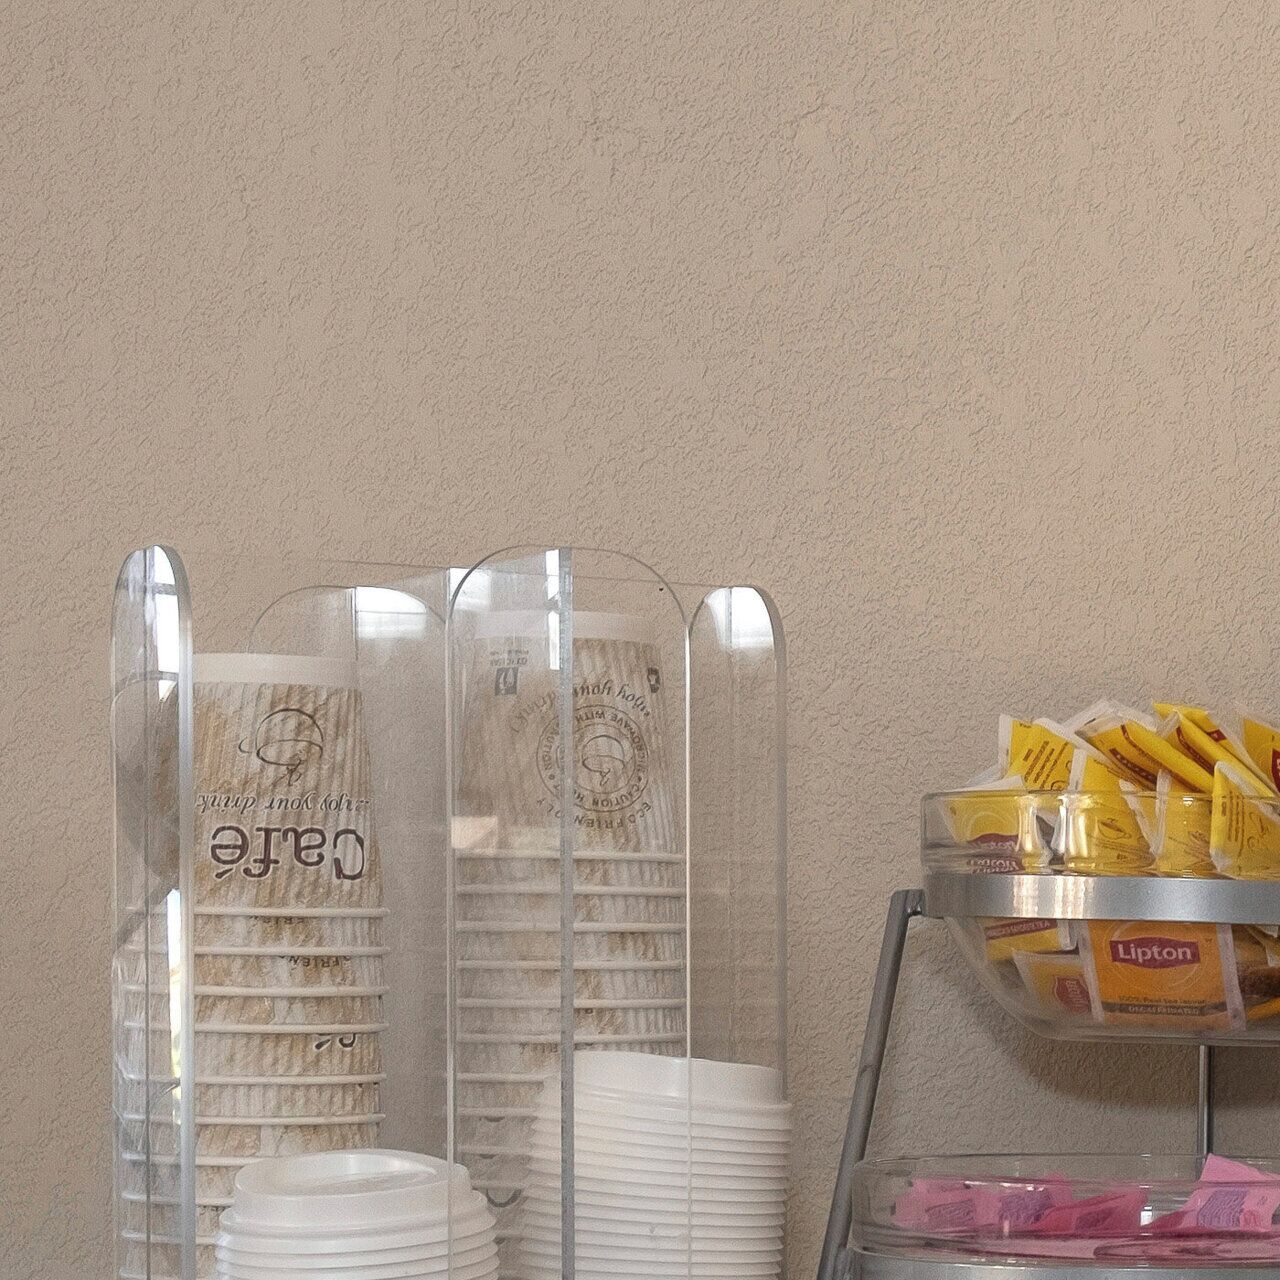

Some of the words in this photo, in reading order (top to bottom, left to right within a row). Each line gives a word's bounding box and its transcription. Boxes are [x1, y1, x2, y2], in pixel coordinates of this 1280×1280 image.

[198, 793, 257, 815] drink
[265, 792, 316, 812] your
[591, 784, 640, 807] CAUTION
[210, 825, 365, 880] Café
[1118, 943, 1193, 963] Lipton
